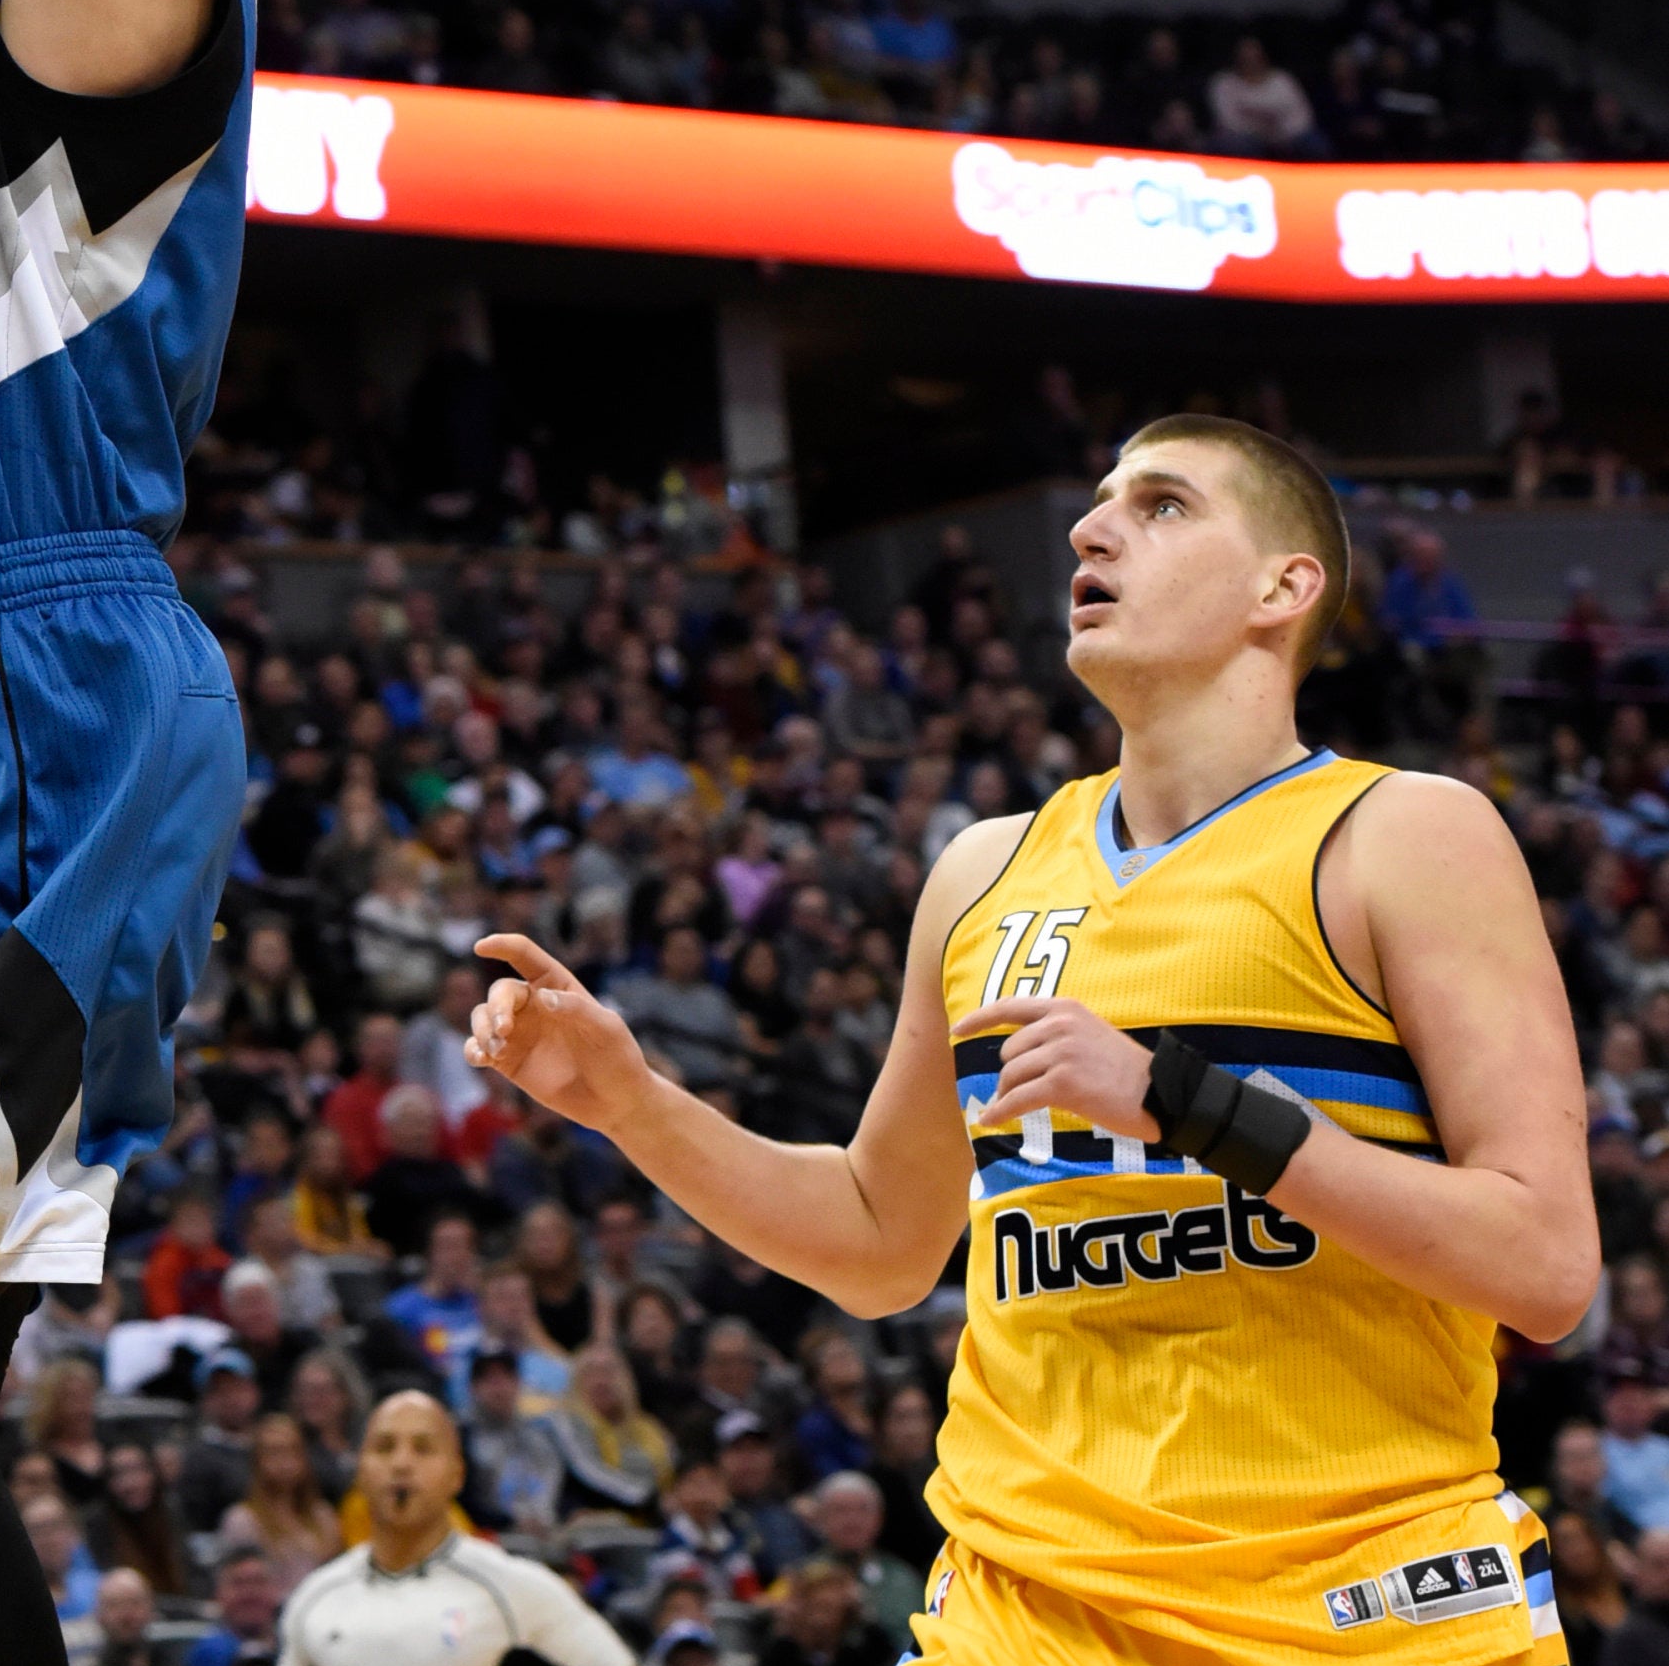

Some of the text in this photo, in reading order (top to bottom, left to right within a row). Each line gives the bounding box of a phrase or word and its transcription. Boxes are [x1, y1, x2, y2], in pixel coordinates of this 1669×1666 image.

[979, 905, 1092, 1009] 15
[1477, 1562, 1502, 1578] 2XL
[1416, 1580, 1451, 1596] adidas
